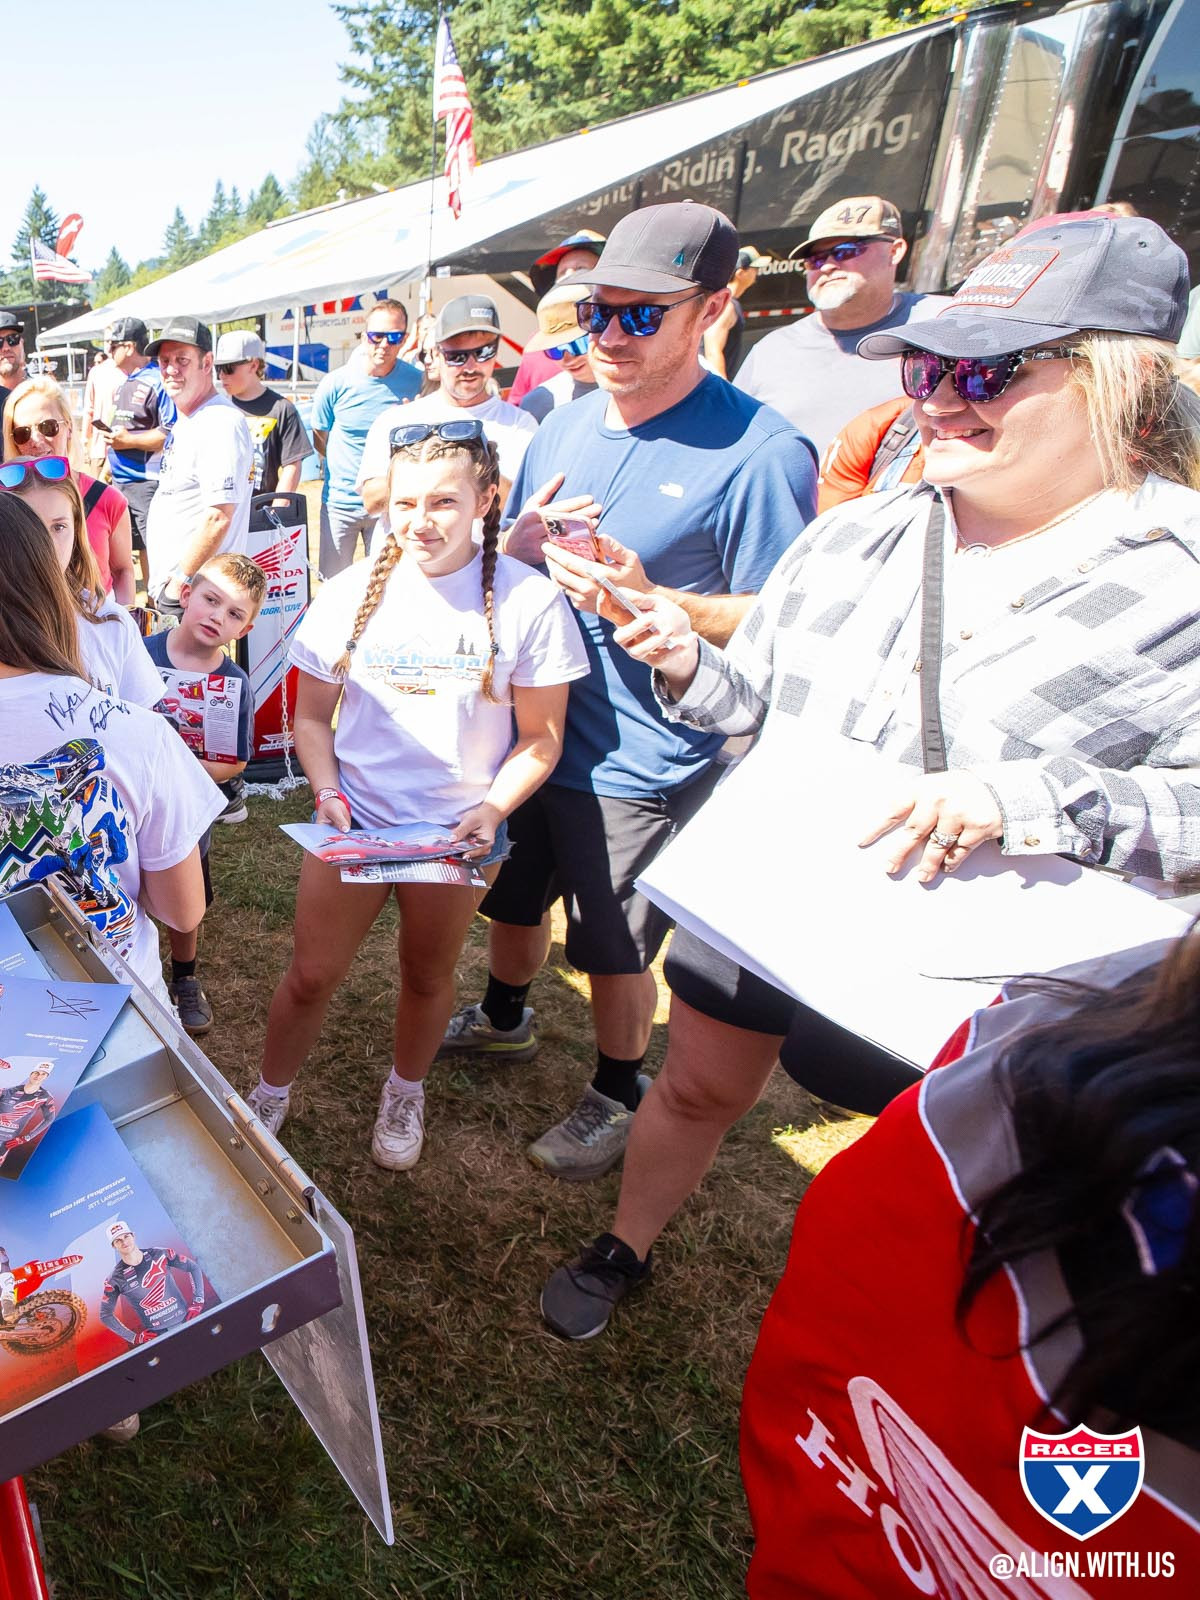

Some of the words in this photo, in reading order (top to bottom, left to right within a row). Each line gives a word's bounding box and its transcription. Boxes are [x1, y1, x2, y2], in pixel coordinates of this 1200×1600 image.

[780, 113, 920, 168] Racing.
[836, 206, 872, 224] 47
[265, 568, 304, 580] ONDA
[364, 648, 490, 669] Washougal
[144, 1296, 177, 1316] HONDA
